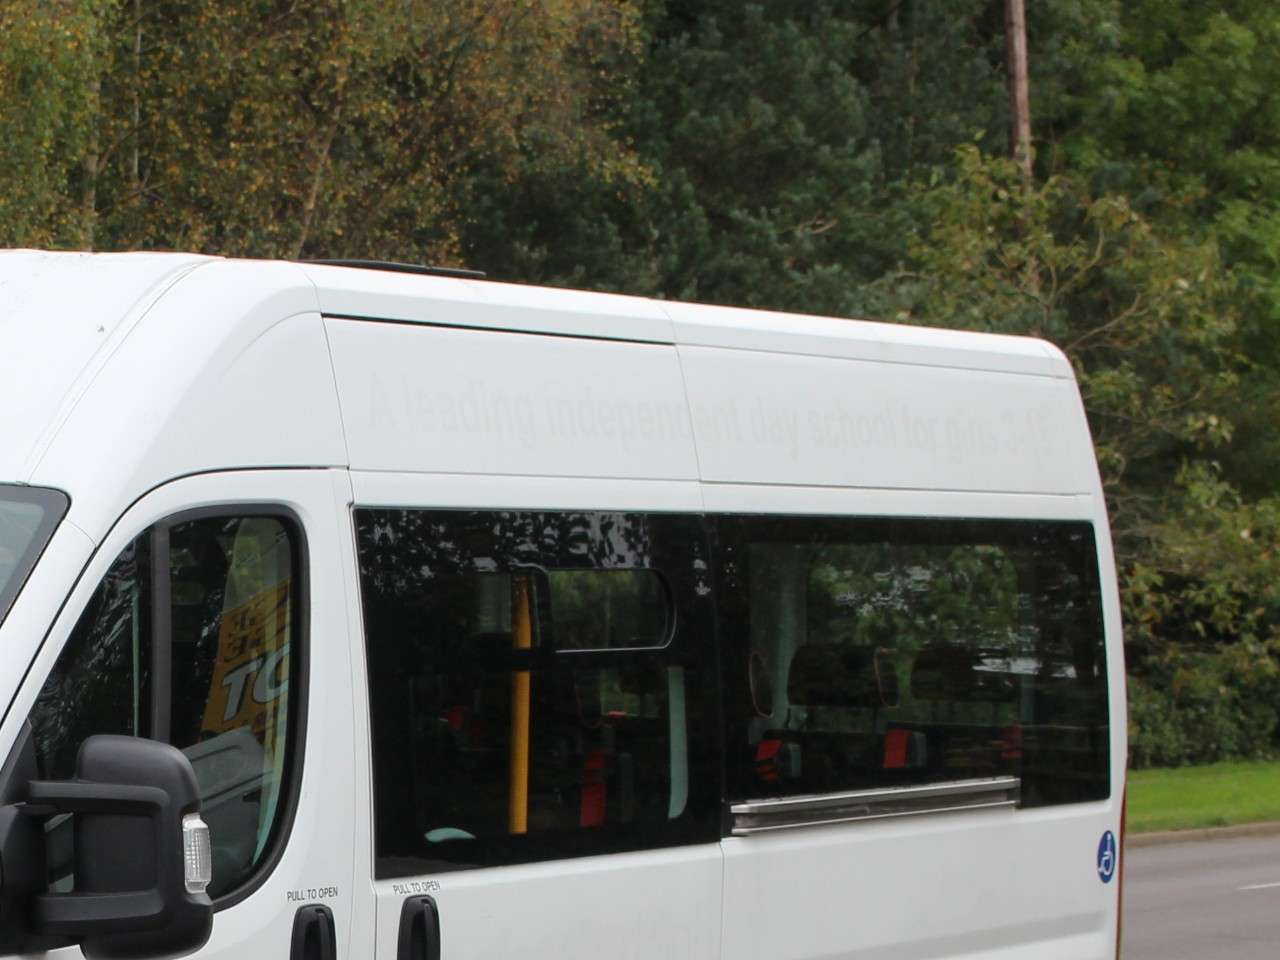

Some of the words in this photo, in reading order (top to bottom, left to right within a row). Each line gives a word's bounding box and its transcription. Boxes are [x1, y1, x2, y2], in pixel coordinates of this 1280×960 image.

[401, 372, 536, 449] leading
[546, 383, 742, 453] independent
[750, 396, 798, 461] day
[808, 396, 895, 450] school
[287, 890, 305, 901] PULL
[307, 888, 317, 899] TO
[319, 886, 338, 899] OPEN
[393, 884, 411, 895] PULL
[411, 882, 421, 893] TO
[422, 880, 440, 892] OPEN
